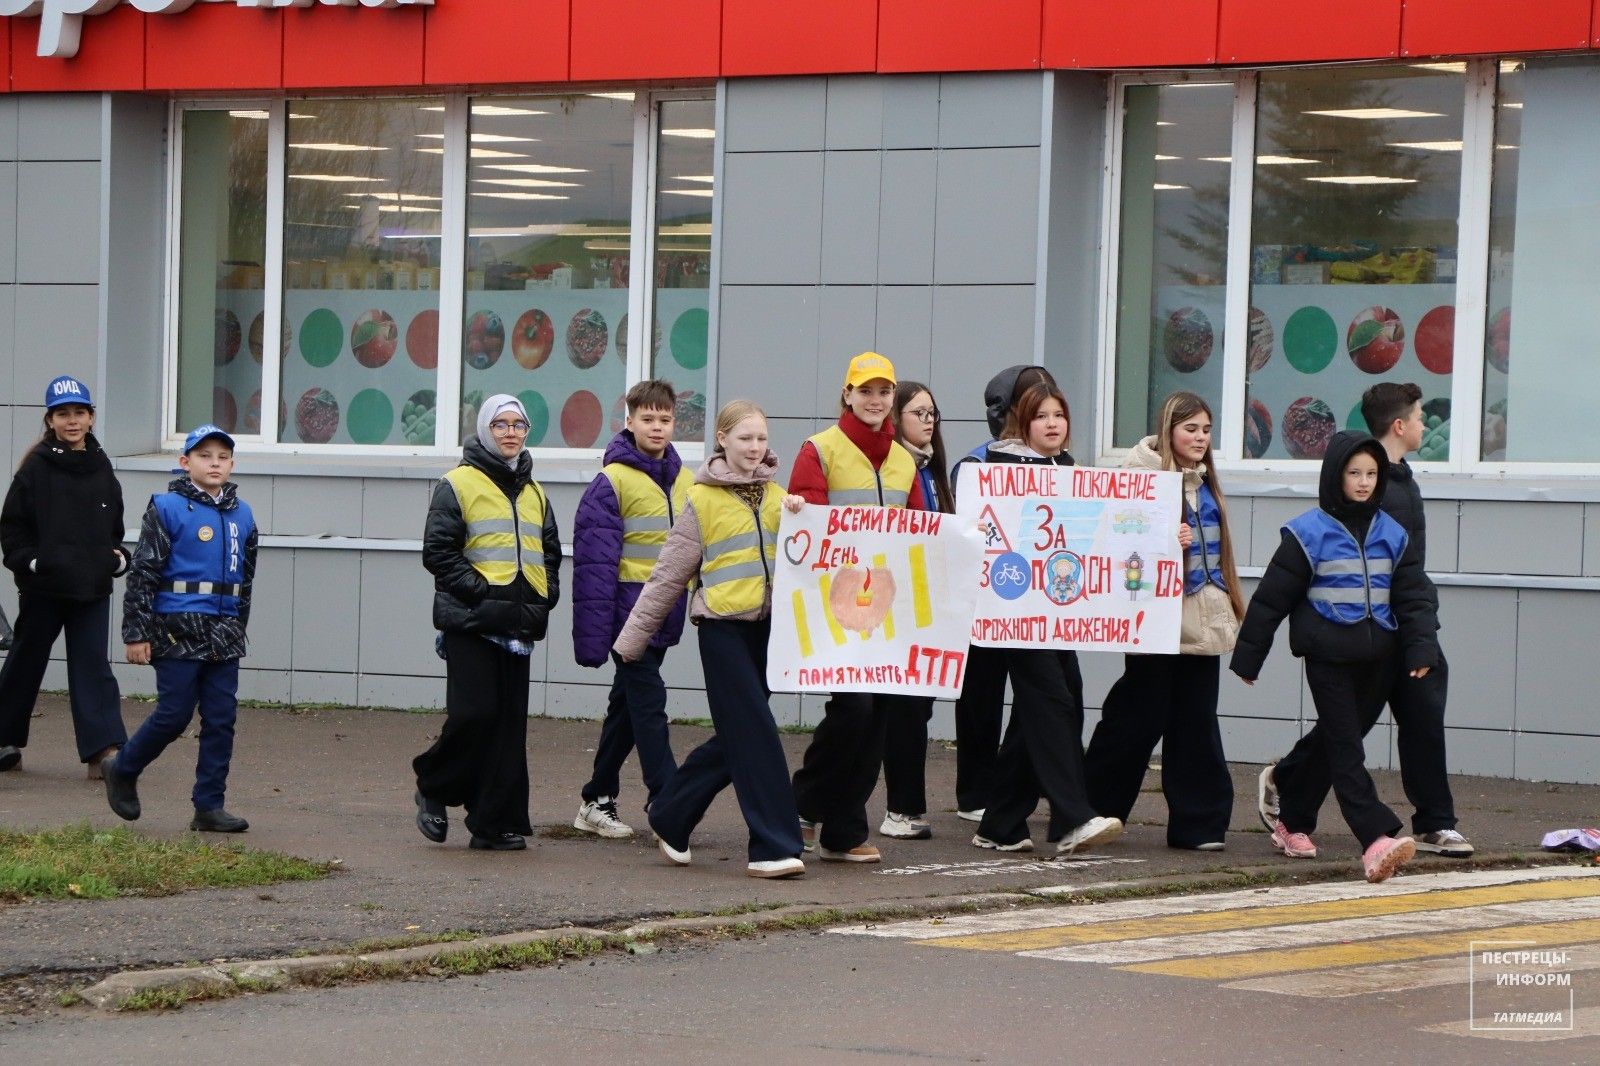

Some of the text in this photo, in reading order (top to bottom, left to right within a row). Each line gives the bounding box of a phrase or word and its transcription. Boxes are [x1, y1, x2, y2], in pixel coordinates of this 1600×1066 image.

[53, 380, 81, 396] ЮИД
[978, 466, 1158, 500] МОЛОДОЕ ПОКОЛЕНИЕ
[229, 521, 239, 573] ЮИД
[799, 666, 861, 686] ПАМЯТИ
[905, 644, 965, 689] ДТП
